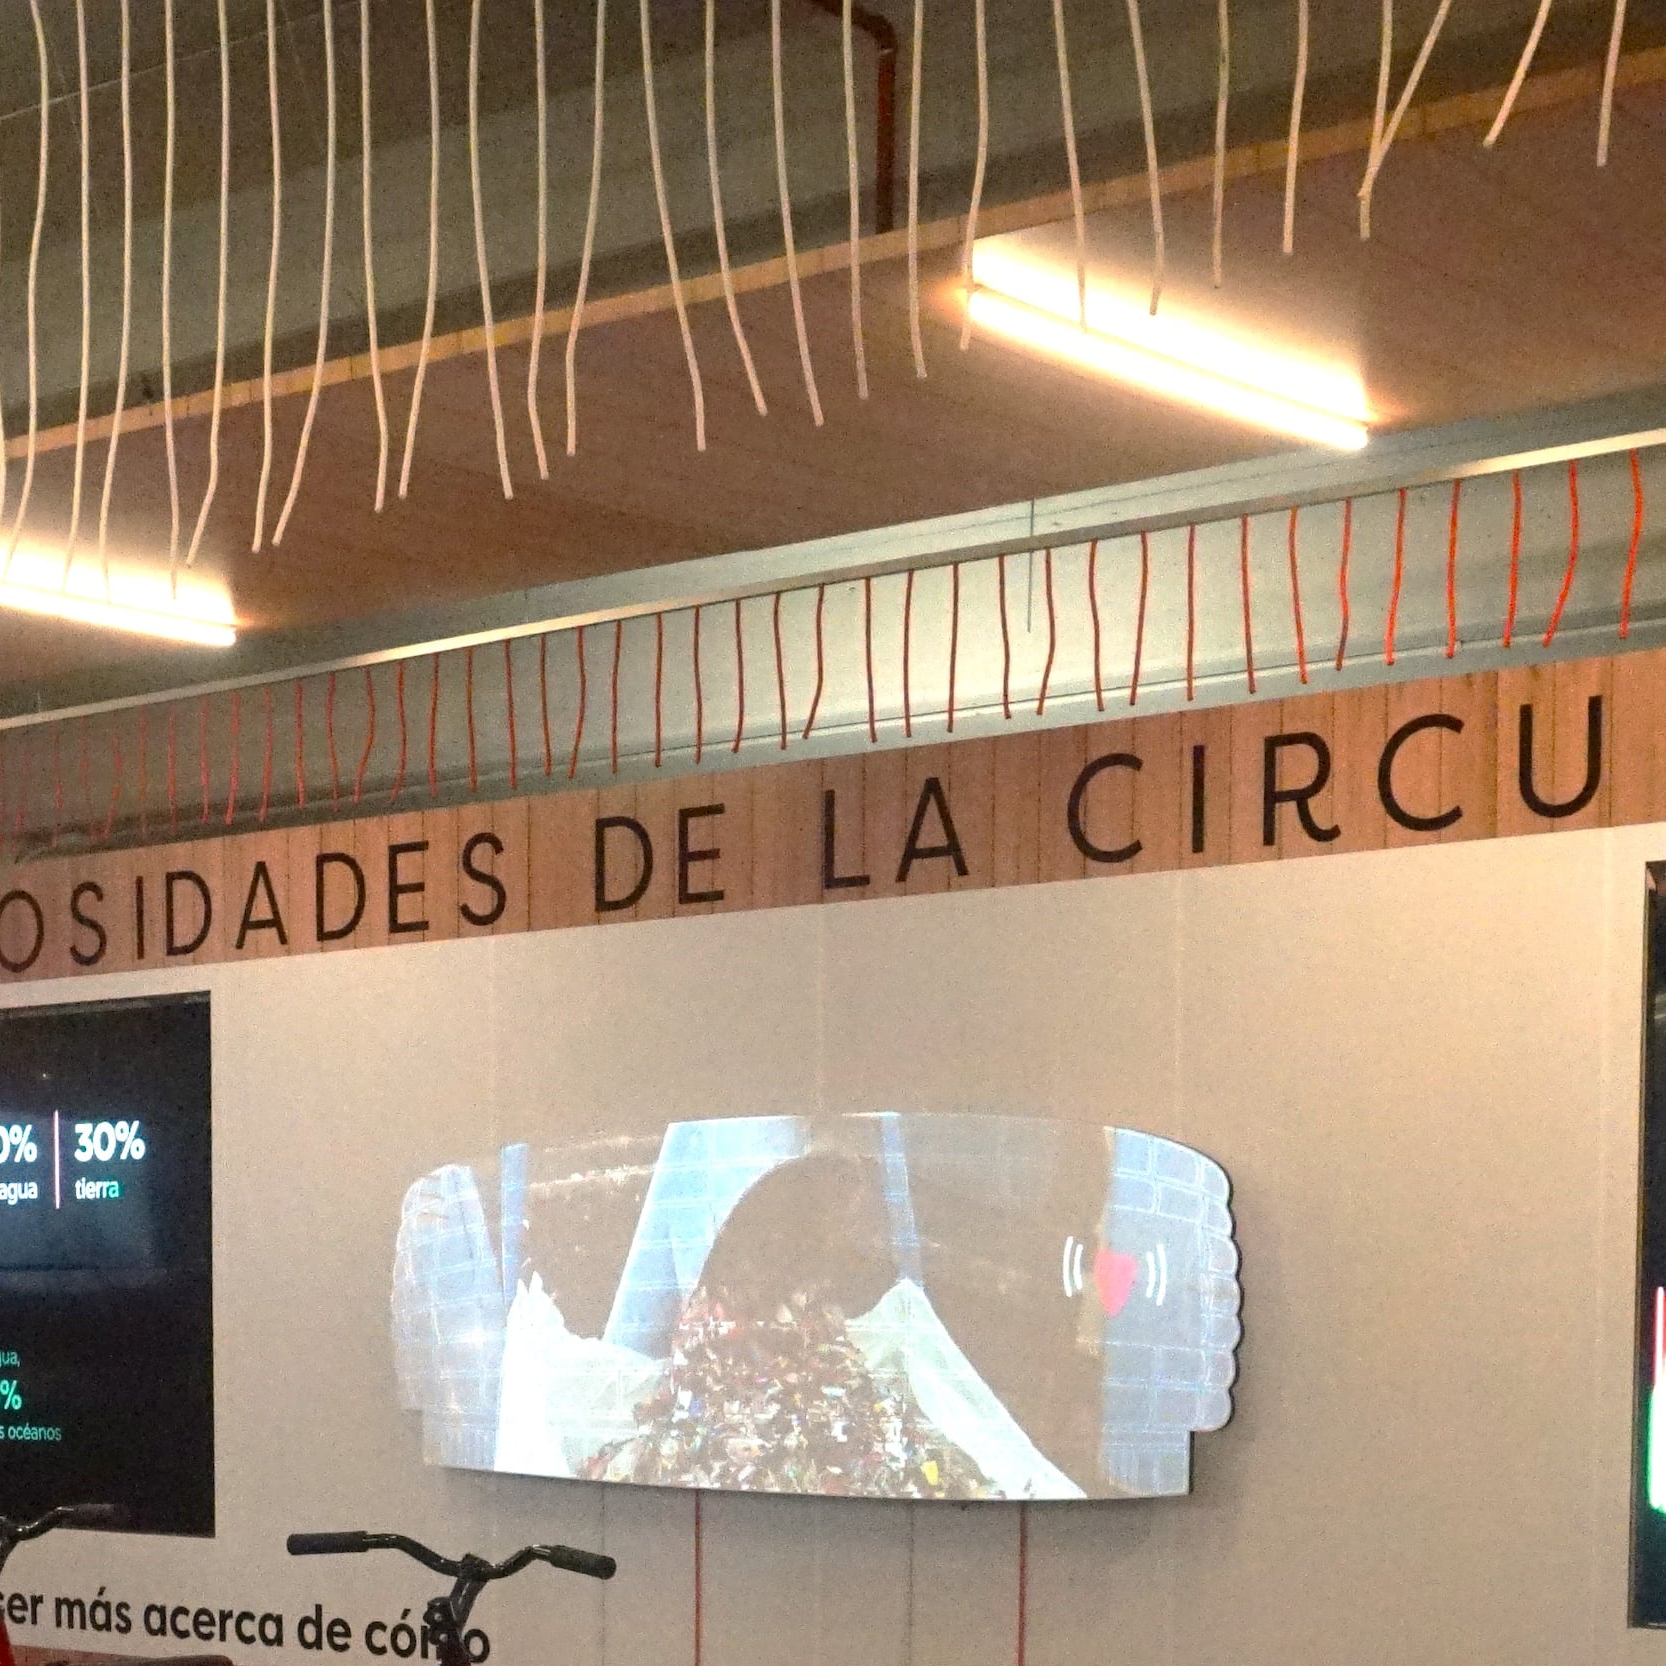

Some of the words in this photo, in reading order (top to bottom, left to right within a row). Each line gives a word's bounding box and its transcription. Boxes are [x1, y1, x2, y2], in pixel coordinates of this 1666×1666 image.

[594, 803, 727, 912] DE
[822, 775, 971, 893] LA
[74, 1120, 146, 1162] 30%
[75, 1177, 119, 1200] tierra
[8, 1421, 63, 1442] océanos
[55, 1585, 133, 1635] más
[144, 1602, 284, 1648] acerca
[296, 1603, 353, 1653] de
